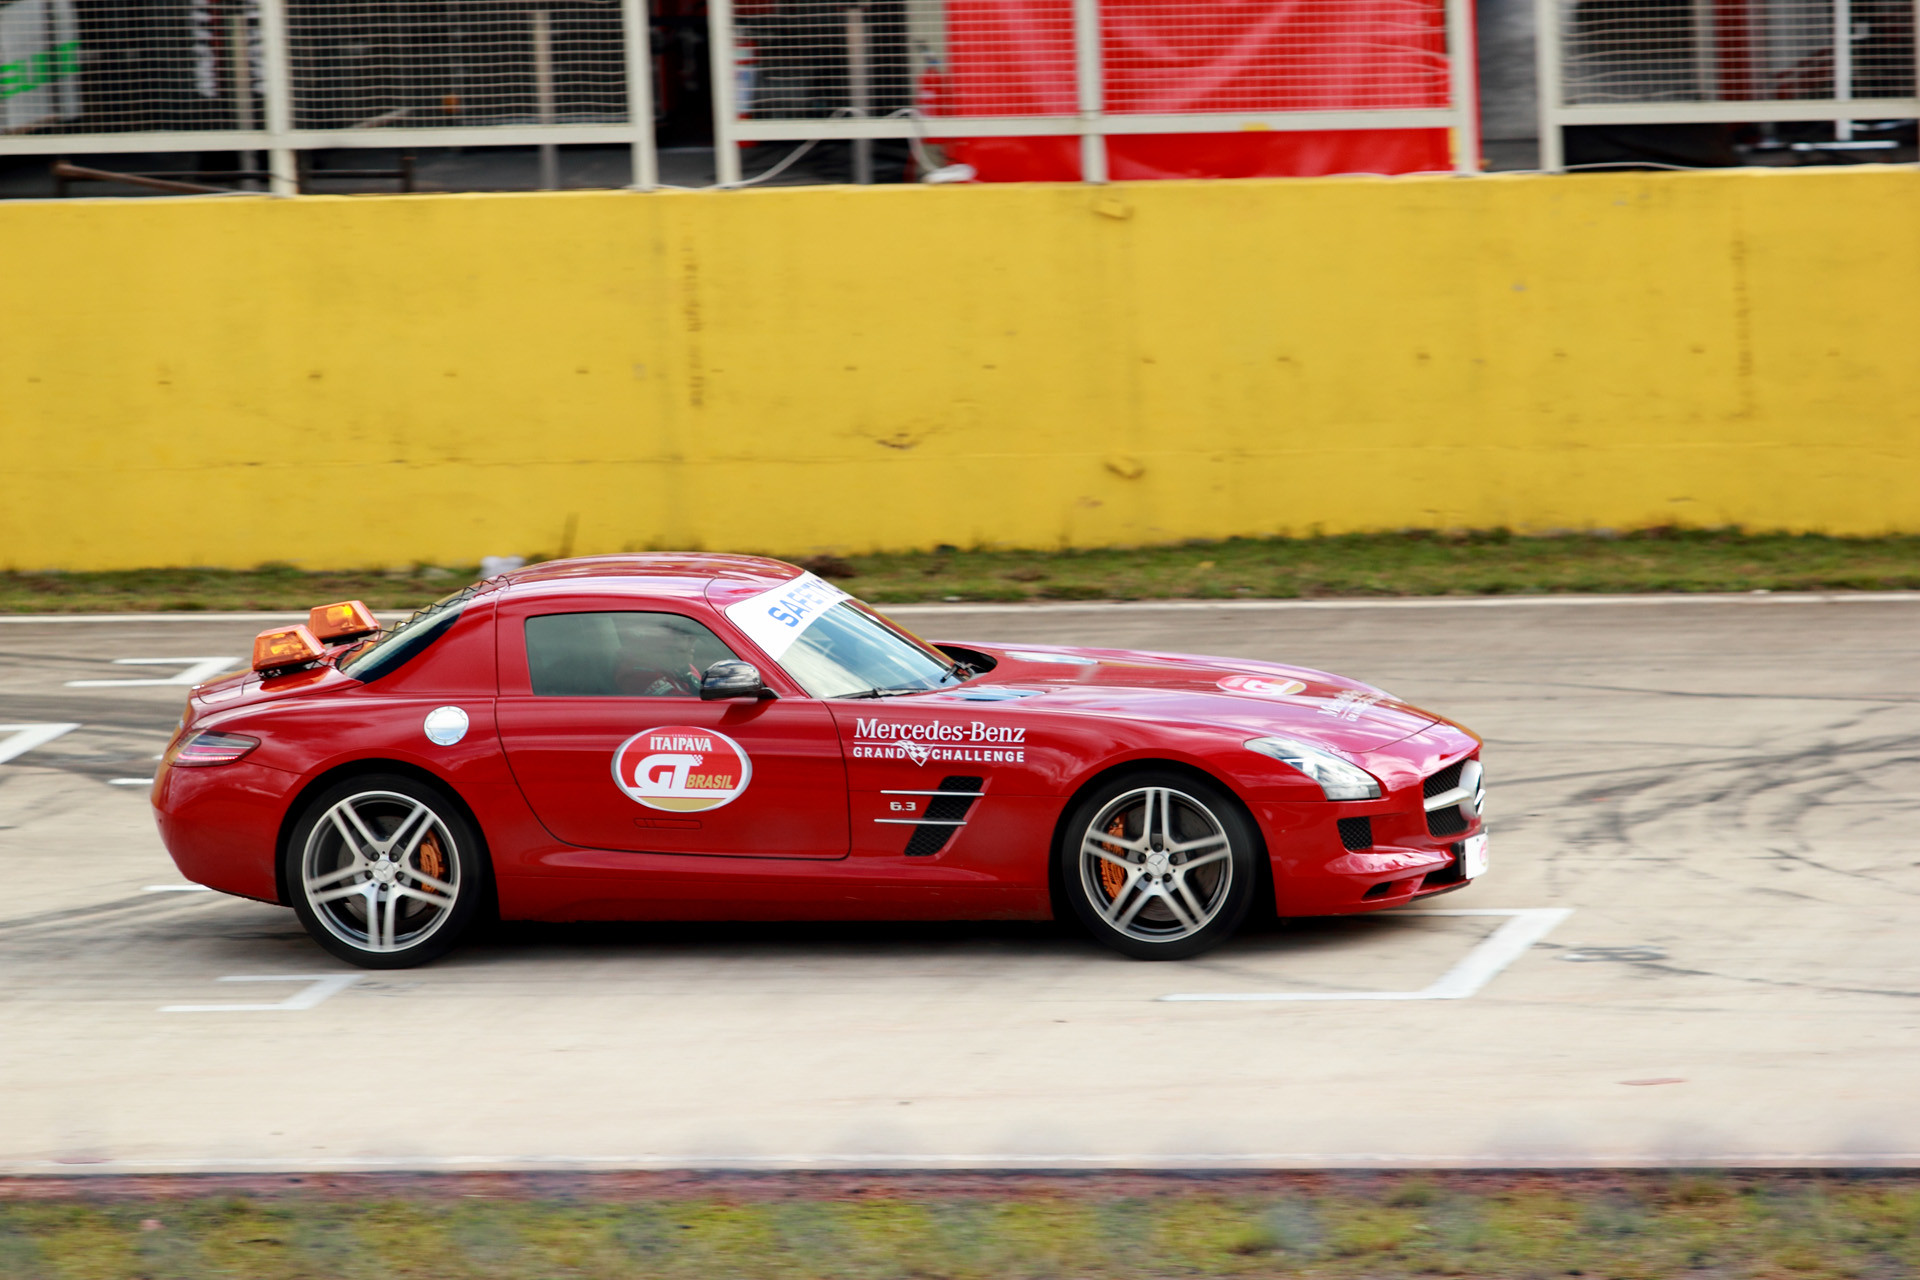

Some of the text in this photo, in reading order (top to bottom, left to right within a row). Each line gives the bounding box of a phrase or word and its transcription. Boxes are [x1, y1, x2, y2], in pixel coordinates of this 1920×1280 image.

[854, 718, 1026, 743] Mercedes-Benz
[650, 736, 713, 752] ITAIPAVA
[853, 747, 1025, 763] GRAND CHALLENGE
[634, 753, 734, 789] GT BRASIL
[889, 801, 917, 812] 6.3
